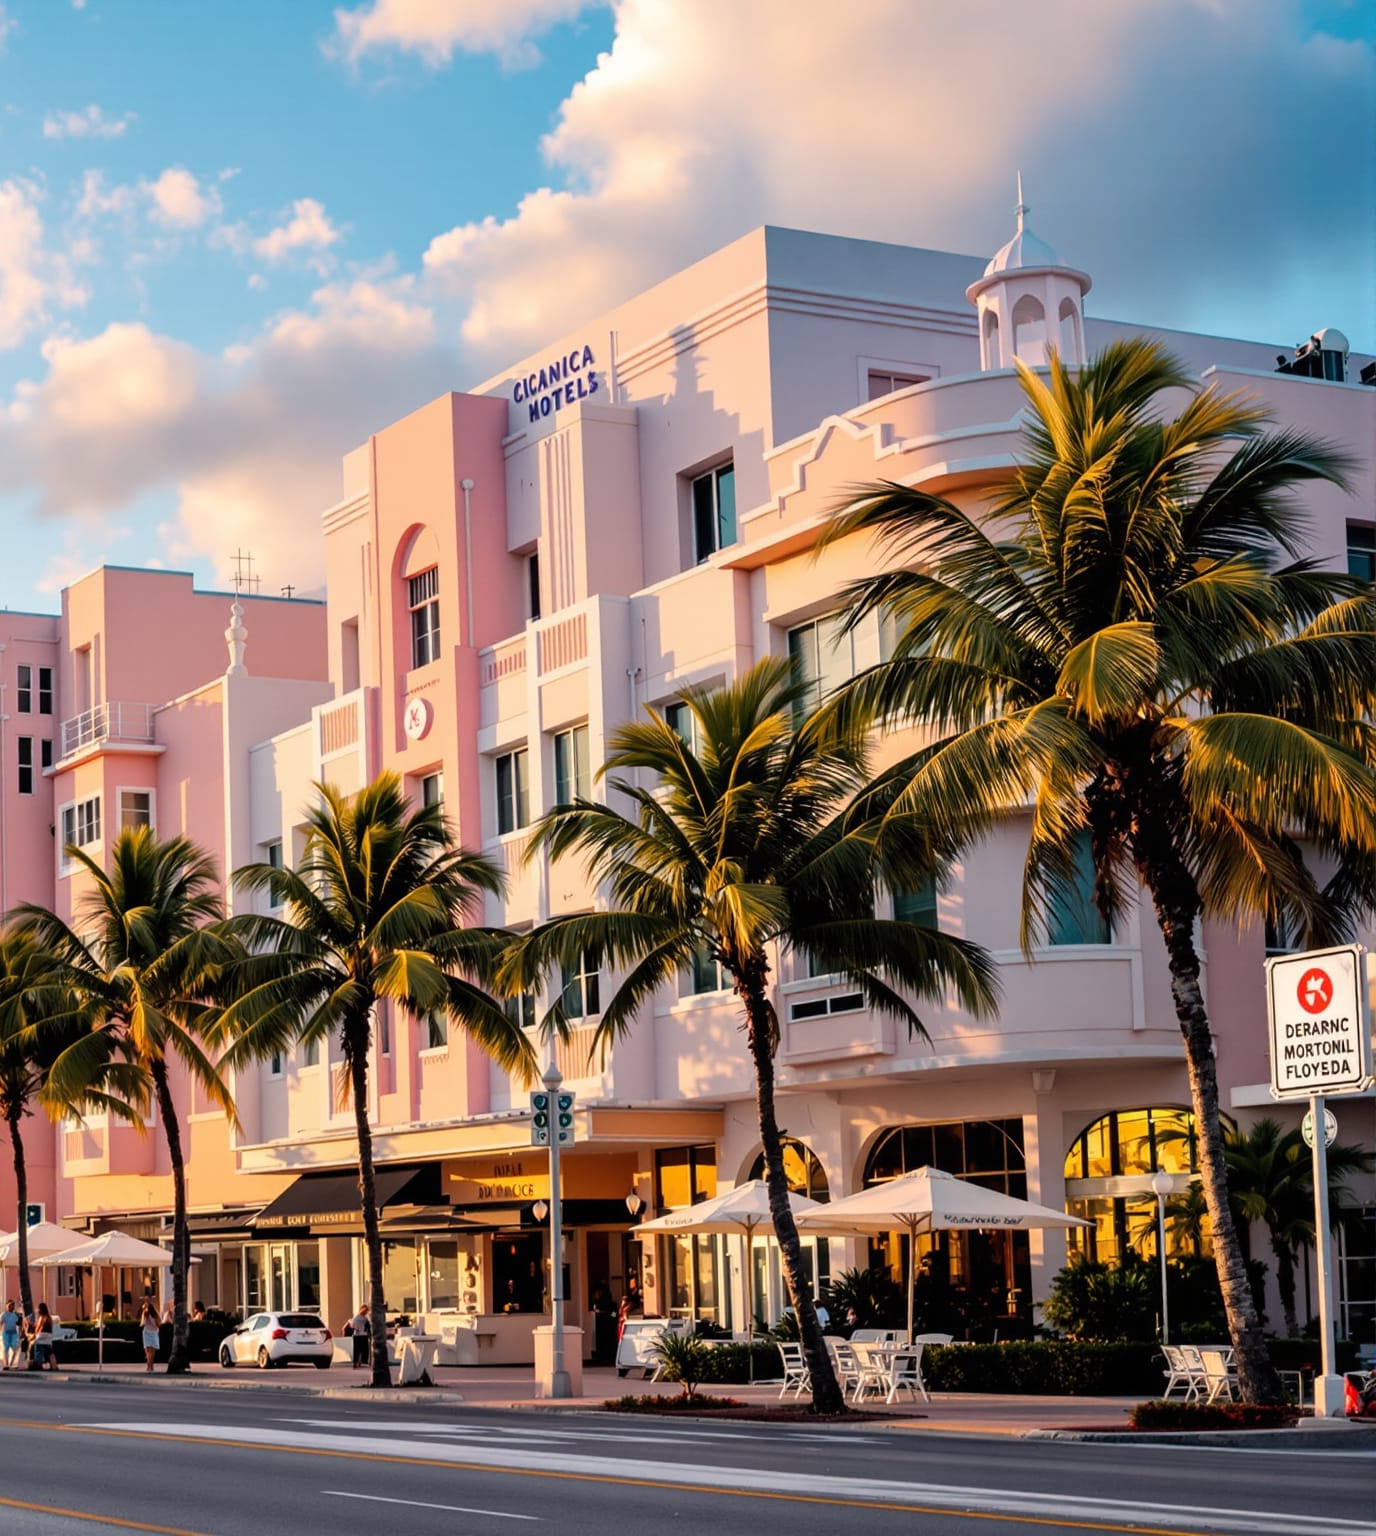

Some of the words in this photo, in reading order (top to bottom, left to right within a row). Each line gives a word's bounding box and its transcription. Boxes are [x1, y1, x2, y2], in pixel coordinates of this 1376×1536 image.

[513, 345, 595, 403] CICANICA
[529, 371, 598, 423] HOTELS
[1286, 1059, 1351, 1079] FLOYEDA
